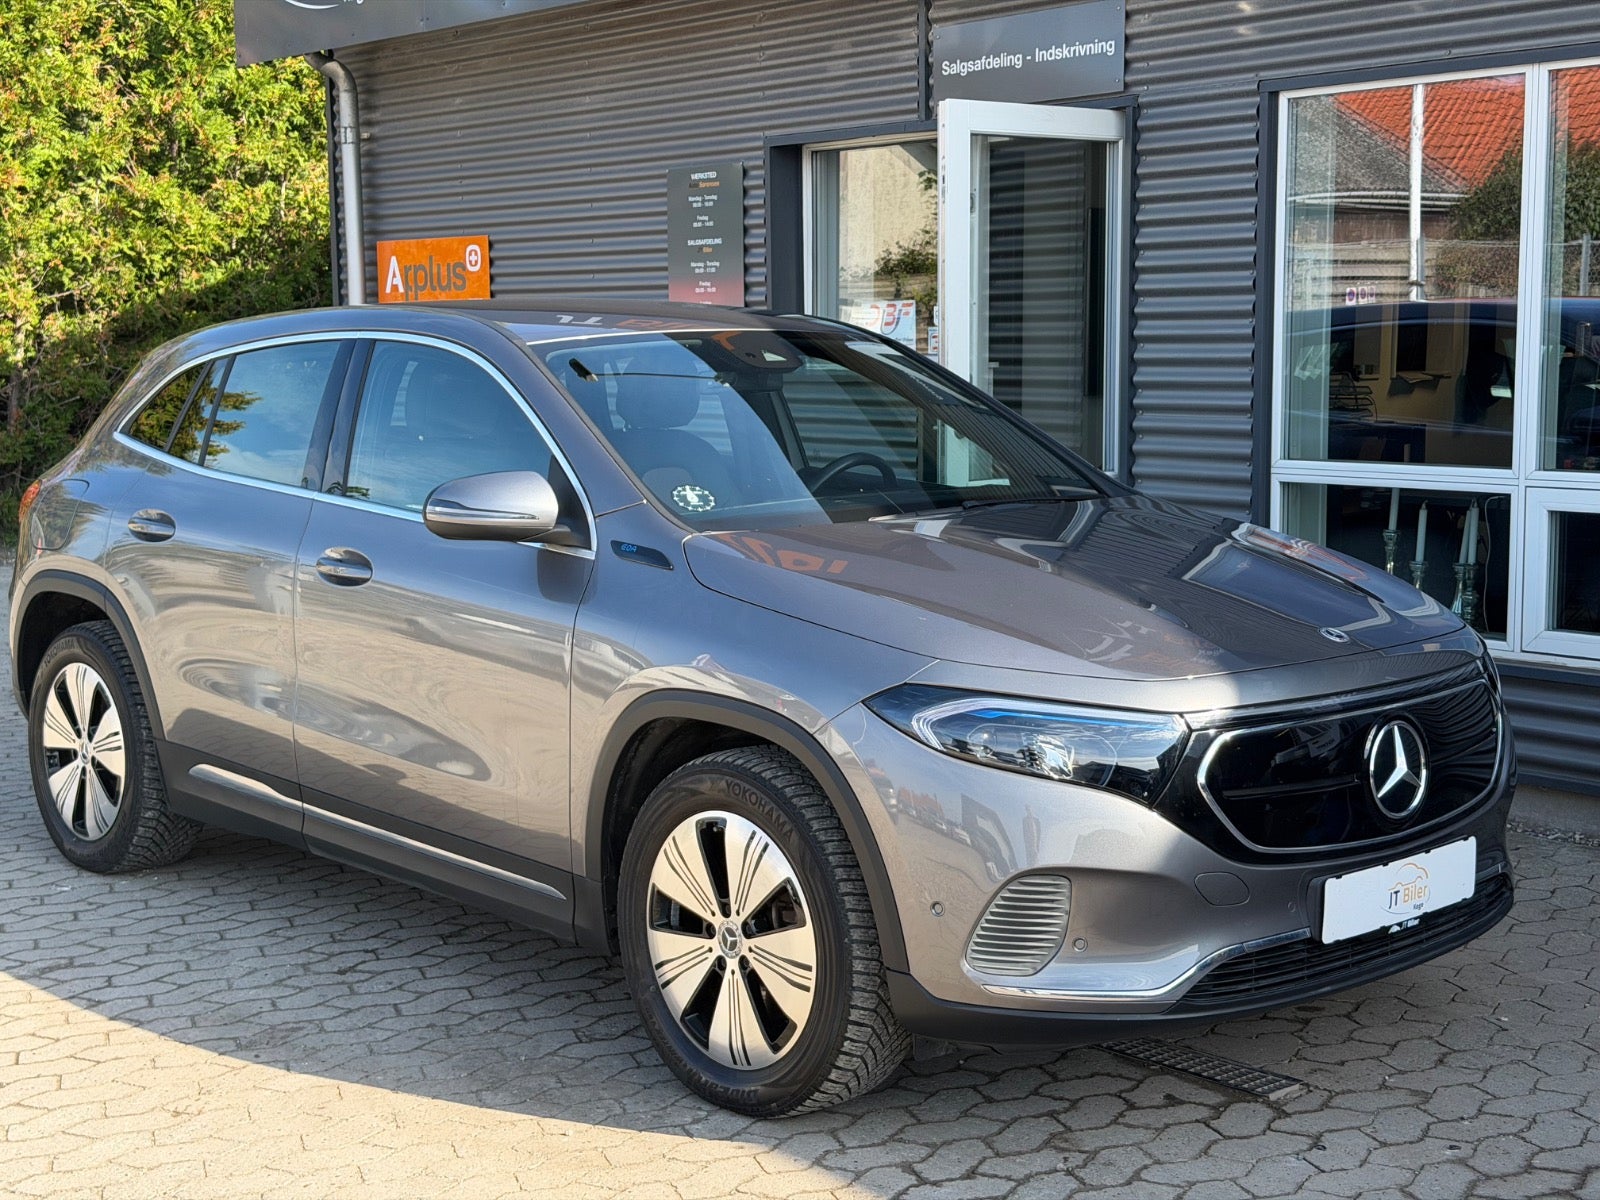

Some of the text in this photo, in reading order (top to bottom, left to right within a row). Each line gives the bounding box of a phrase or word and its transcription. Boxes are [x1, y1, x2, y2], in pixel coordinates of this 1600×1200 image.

[941, 52, 1023, 77] Salgsafdeling
[1035, 39, 1116, 63] Indskrivning
[725, 780, 794, 842] YOKOHAMA
[1389, 884, 1427, 909] JT Biler
